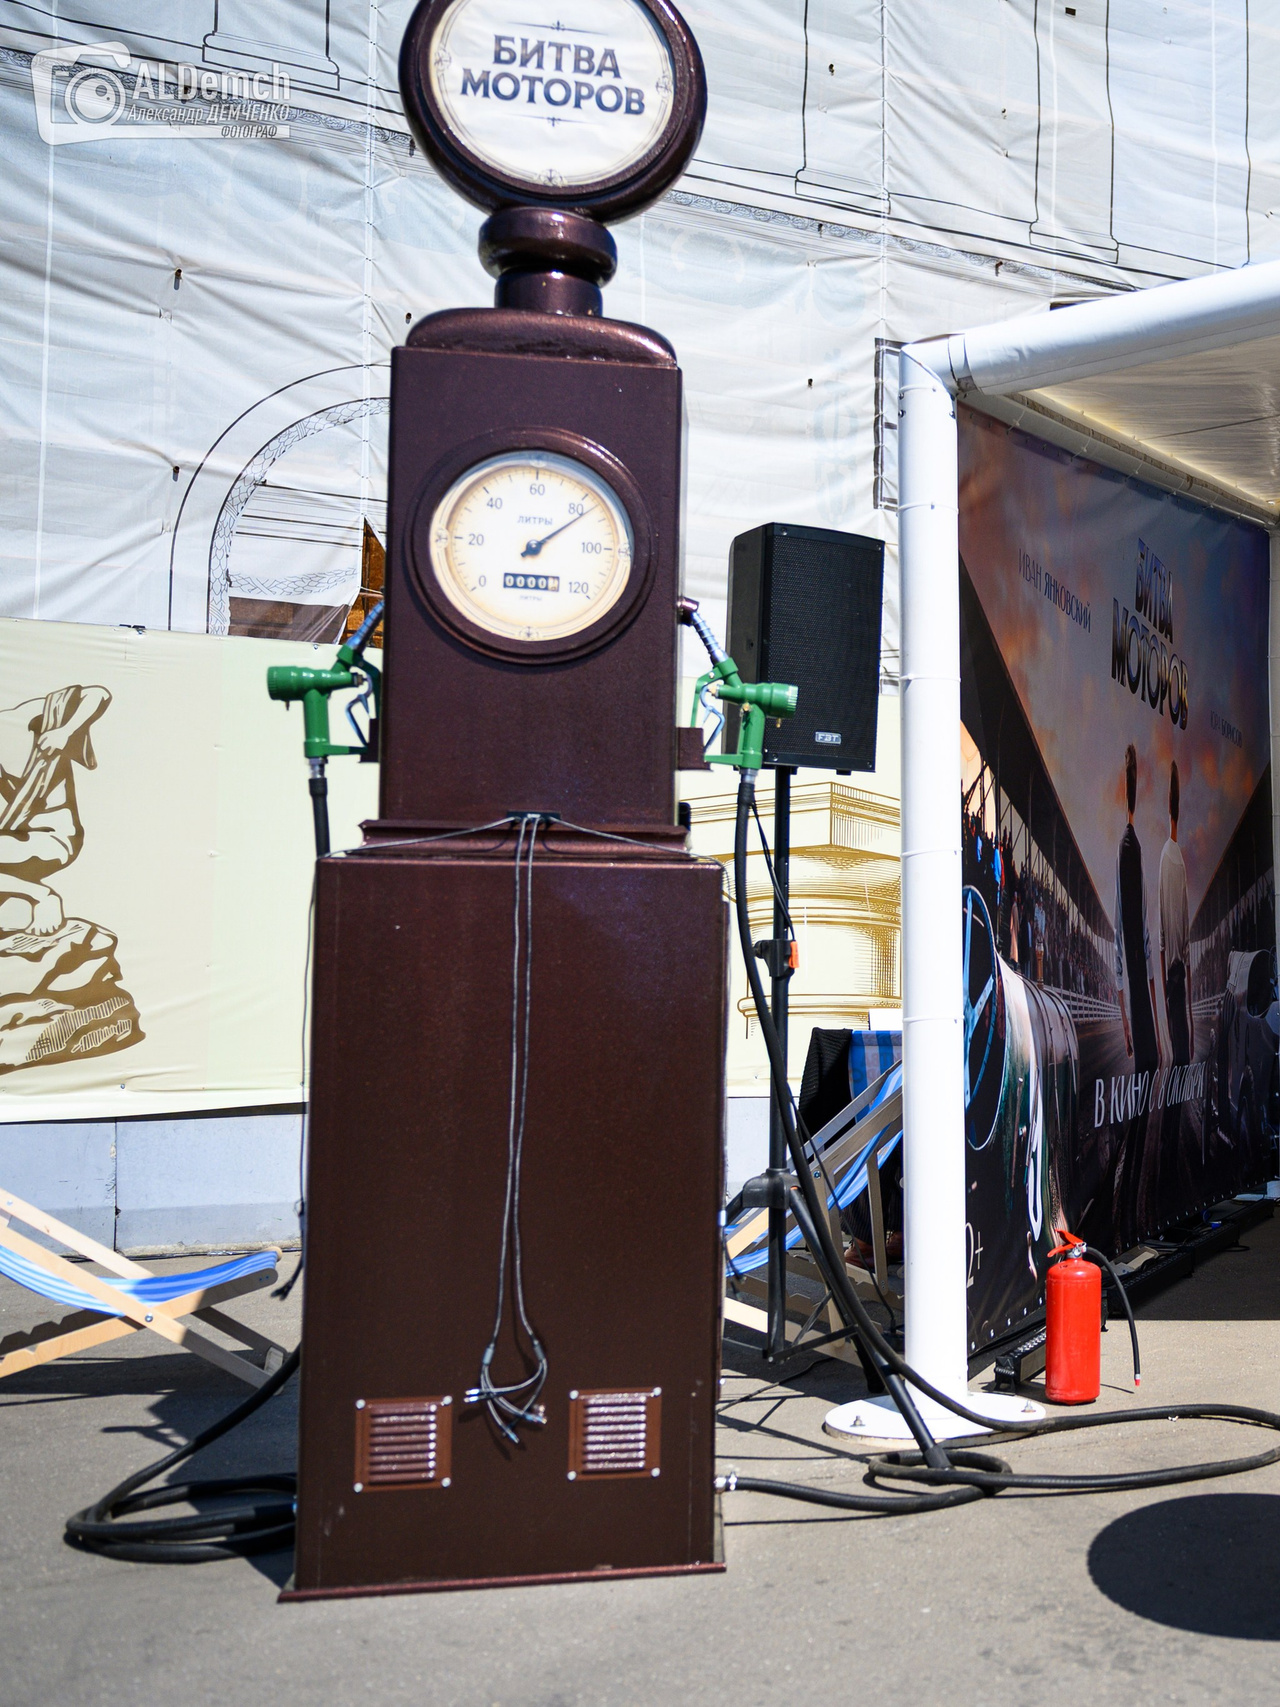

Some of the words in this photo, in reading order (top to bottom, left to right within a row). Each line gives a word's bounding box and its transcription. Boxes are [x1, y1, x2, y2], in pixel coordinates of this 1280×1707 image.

[492, 33, 622, 80] БИТВА
[460, 67, 646, 116] МОТОРОВ
[529, 483, 546, 496] 60
[486, 496, 503, 510] 40
[567, 502, 585, 516] 80
[516, 515, 553, 526] ЛИТРЫ
[468, 533, 485, 547] 20
[581, 541, 603, 555] 100
[478, 574, 487, 588] 0
[568, 581, 590, 595] 120
[1018, 548, 1042, 593] ИВАН
[1043, 571, 1091, 634] ЯНКОВСКИЙ
[1134, 537, 1174, 645] БИТВА
[1111, 597, 1189, 731] МОТОРОВ
[1094, 1078, 1105, 1128] В
[1110, 1070, 1150, 1125] КИНО
[1148, 1068, 1160, 1113] С
[1157, 1067, 1169, 1110] 8
